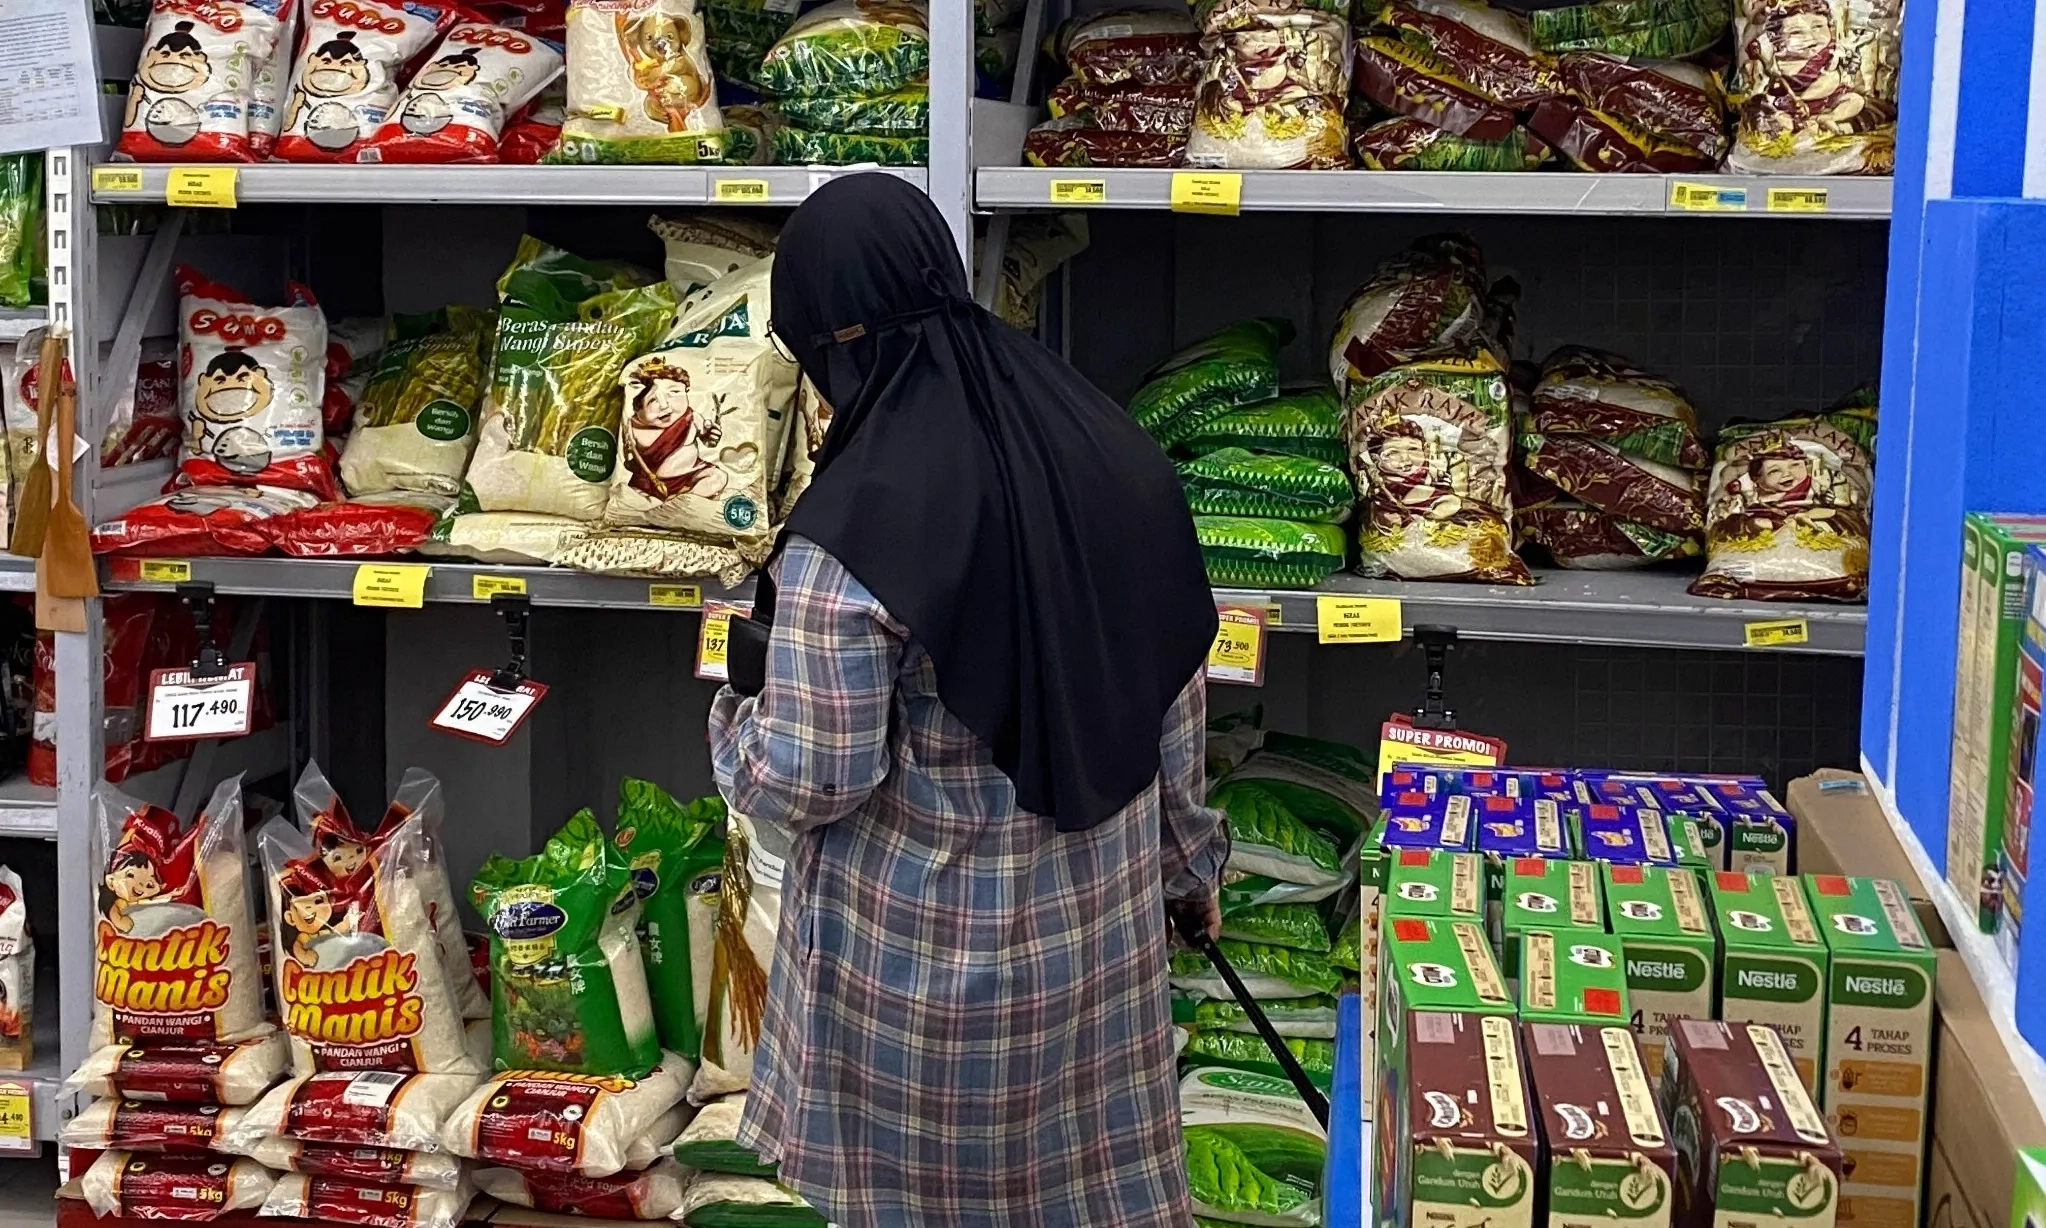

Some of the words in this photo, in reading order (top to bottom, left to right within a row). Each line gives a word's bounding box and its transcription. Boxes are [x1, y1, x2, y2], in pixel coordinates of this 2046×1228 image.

[501, 317, 548, 334] Beras
[706, 637, 726, 652] 137
[172, 699, 238, 728] 117.490
[1388, 727, 1432, 746] SUPER
[1434, 733, 1491, 755] PROMO!
[519, 911, 561, 928] Farmer
[283, 949, 417, 1004] Cantik
[1627, 959, 1686, 980] Nestlé
[97, 962, 231, 1012] Manis
[1738, 968, 1797, 990] Nestlé
[1845, 975, 1906, 996] Nestlé
[122, 1015, 164, 1026] PANDAN
[165, 1015, 202, 1027] WANGI
[288, 996, 422, 1044] Manis
[1630, 1009, 1645, 1034] 4
[140, 1026, 185, 1036] CIANJUR
[1844, 1025, 1863, 1052] 4
[1871, 1029, 1910, 1041] TAHAP
[321, 1046, 363, 1057] PANDAN
[364, 1043, 400, 1056] WANGI
[1866, 1042, 1912, 1054] PROSES
[340, 1057, 383, 1067] CIANJUR
[552, 1131, 576, 1150] 5kg
[1417, 1175, 1456, 1188] Gandum
[199, 1187, 223, 1203] 5kg
[385, 1191, 408, 1208] 5kg
